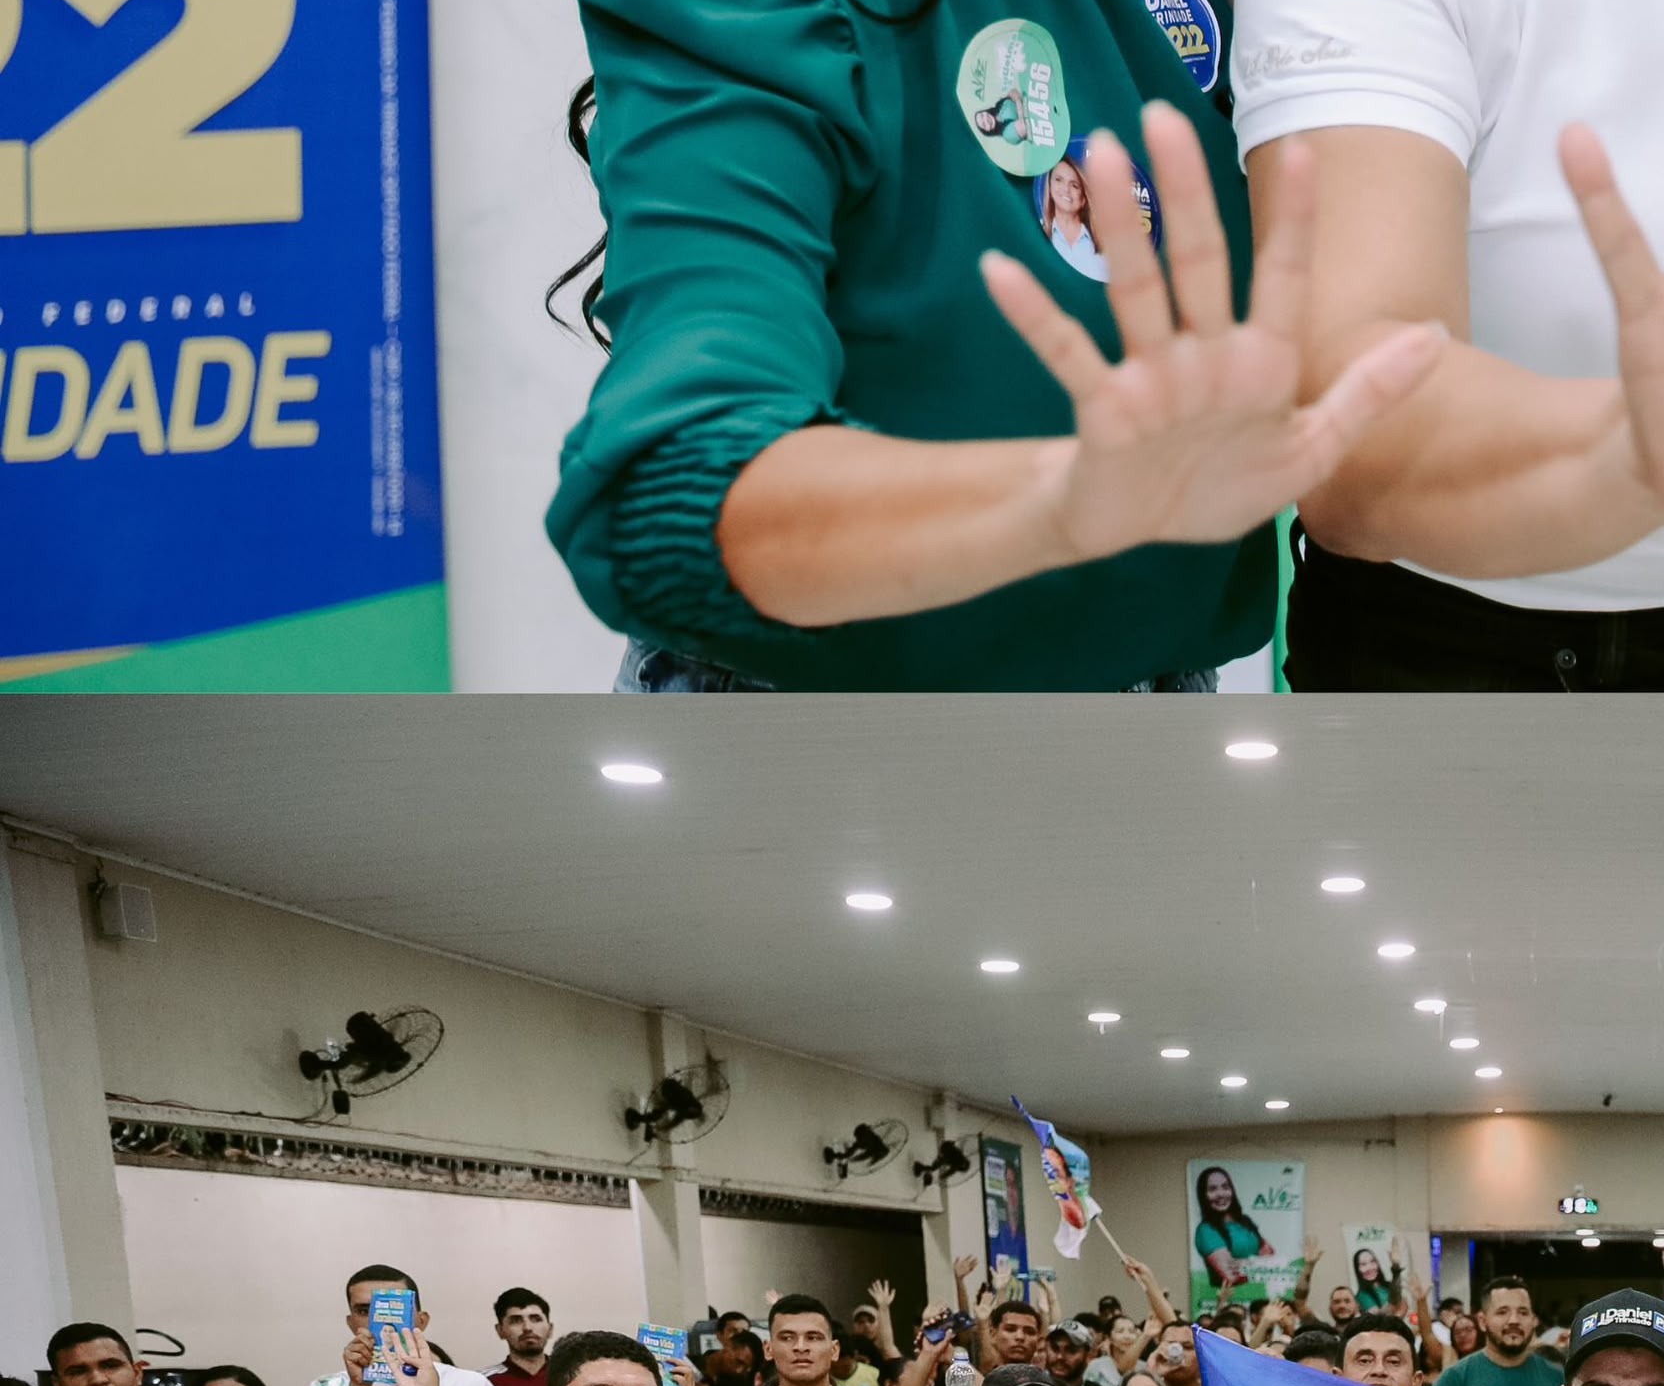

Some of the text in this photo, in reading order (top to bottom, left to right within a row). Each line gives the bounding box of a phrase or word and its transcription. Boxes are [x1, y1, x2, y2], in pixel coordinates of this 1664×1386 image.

[1028, 62, 1057, 147] 15456
[42, 290, 256, 328] FEDERAL
[0, 330, 332, 463] DADE
[1606, 1307, 1652, 1322] Daniel
[1615, 1317, 1652, 1327] Trindade
